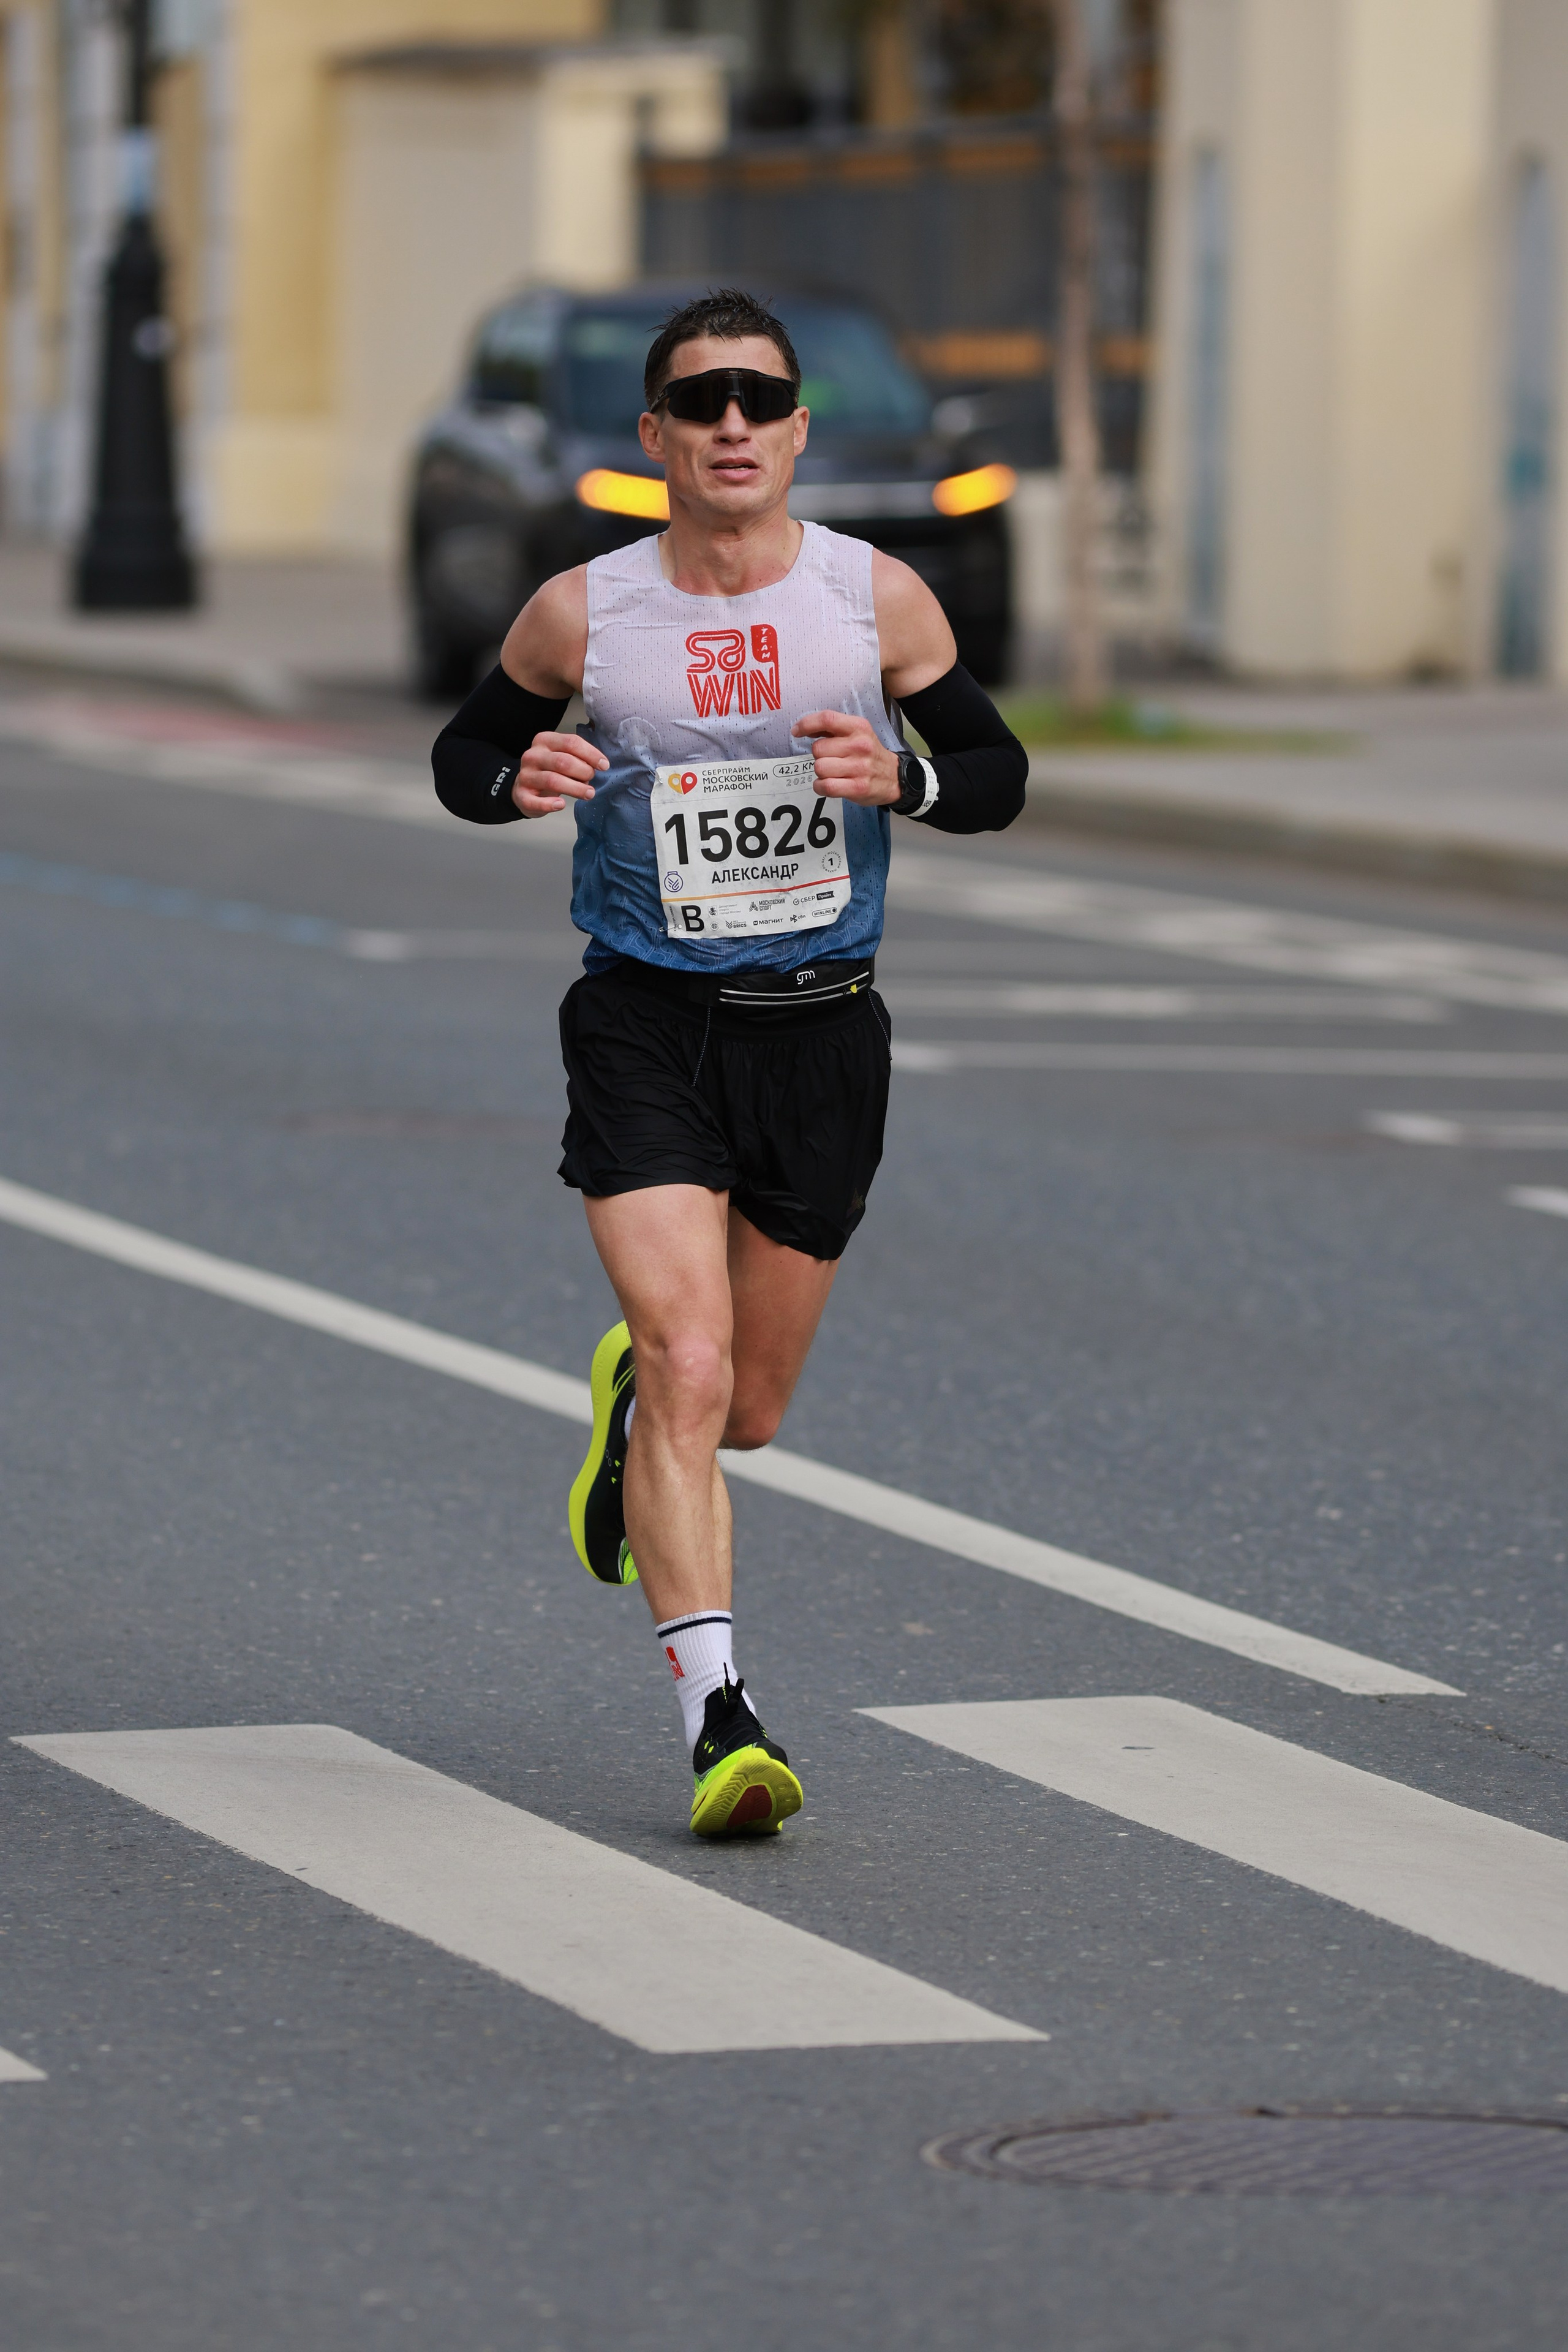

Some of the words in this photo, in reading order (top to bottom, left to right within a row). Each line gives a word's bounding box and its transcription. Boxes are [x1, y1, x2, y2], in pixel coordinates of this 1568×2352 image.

[761, 628, 771, 659] TEAM
[687, 668, 781, 717] WIN
[702, 767, 750, 776] СБЕРПРАЙМ
[778, 765, 799, 774] 42,2
[703, 772, 768, 785] МОСКОВСКИЙ
[703, 783, 752, 793] МАРАФОН
[665, 796, 836, 865] 15826
[712, 863, 799, 884] АЛЕКСАНДР
